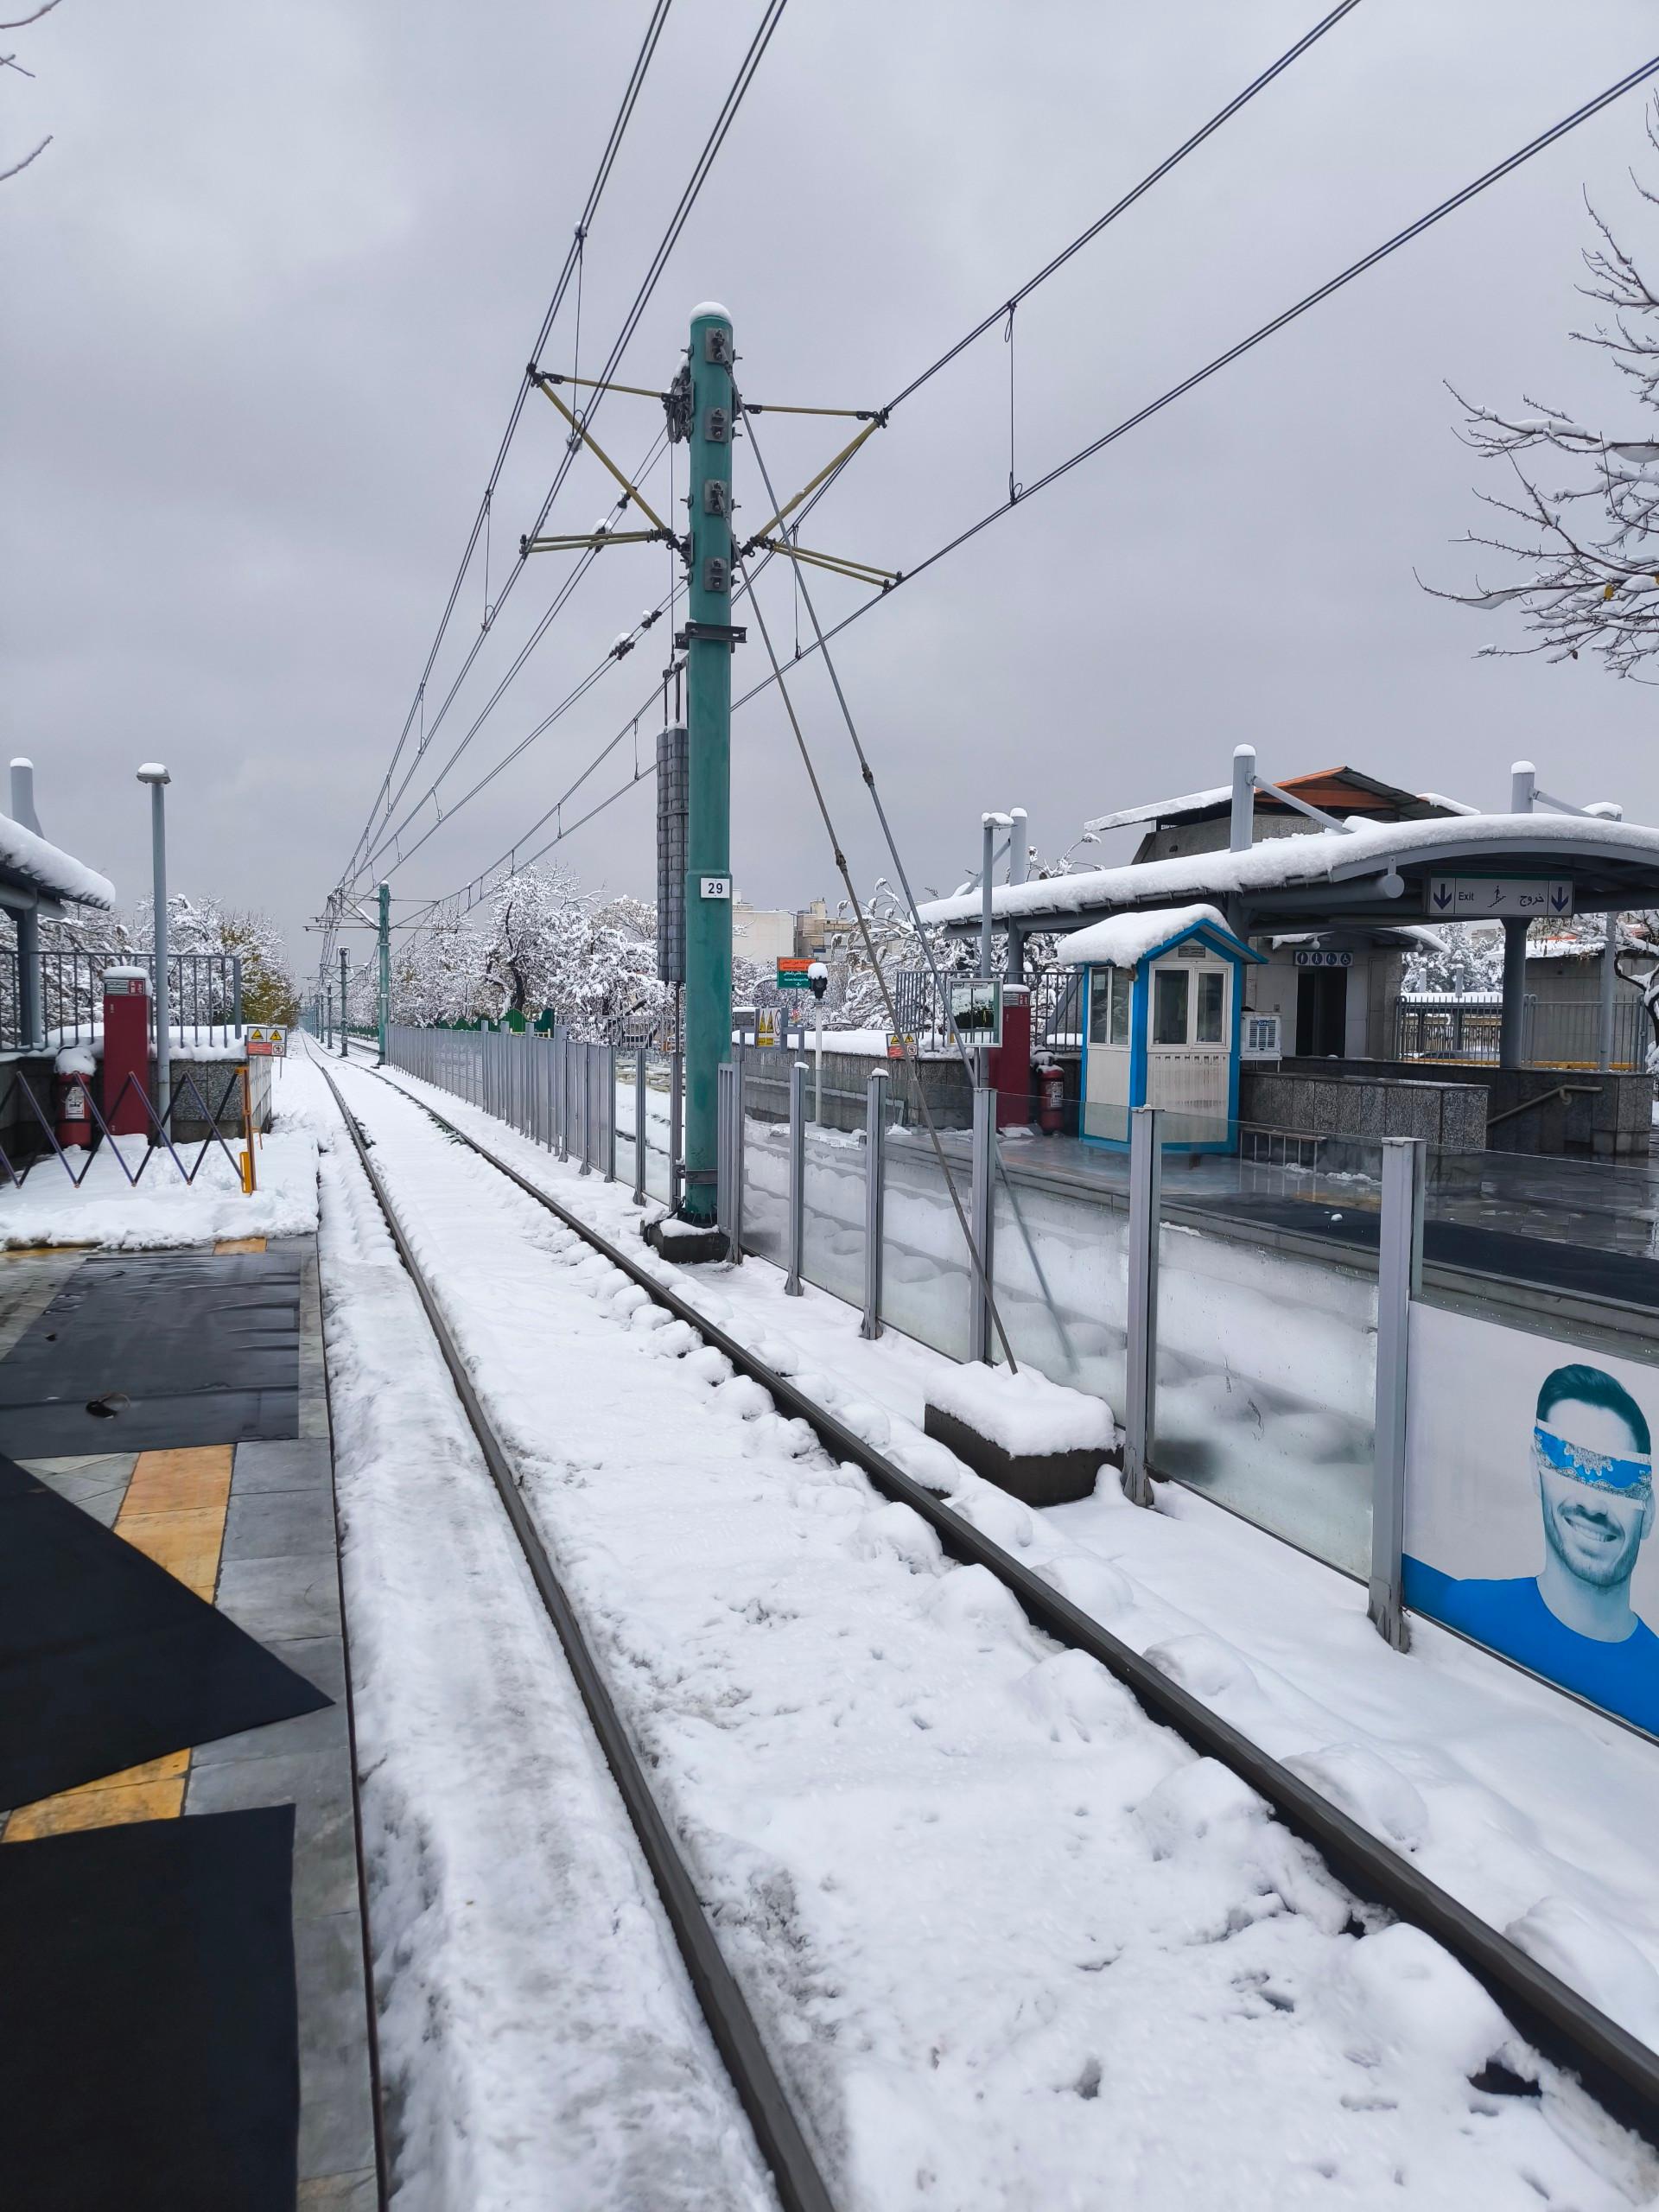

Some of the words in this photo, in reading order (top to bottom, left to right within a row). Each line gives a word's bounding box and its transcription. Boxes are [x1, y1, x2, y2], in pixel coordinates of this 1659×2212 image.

[708, 882, 723, 894] 29
[1459, 892, 1474, 901] Exit
[1519, 893, 1545, 907] خروج
